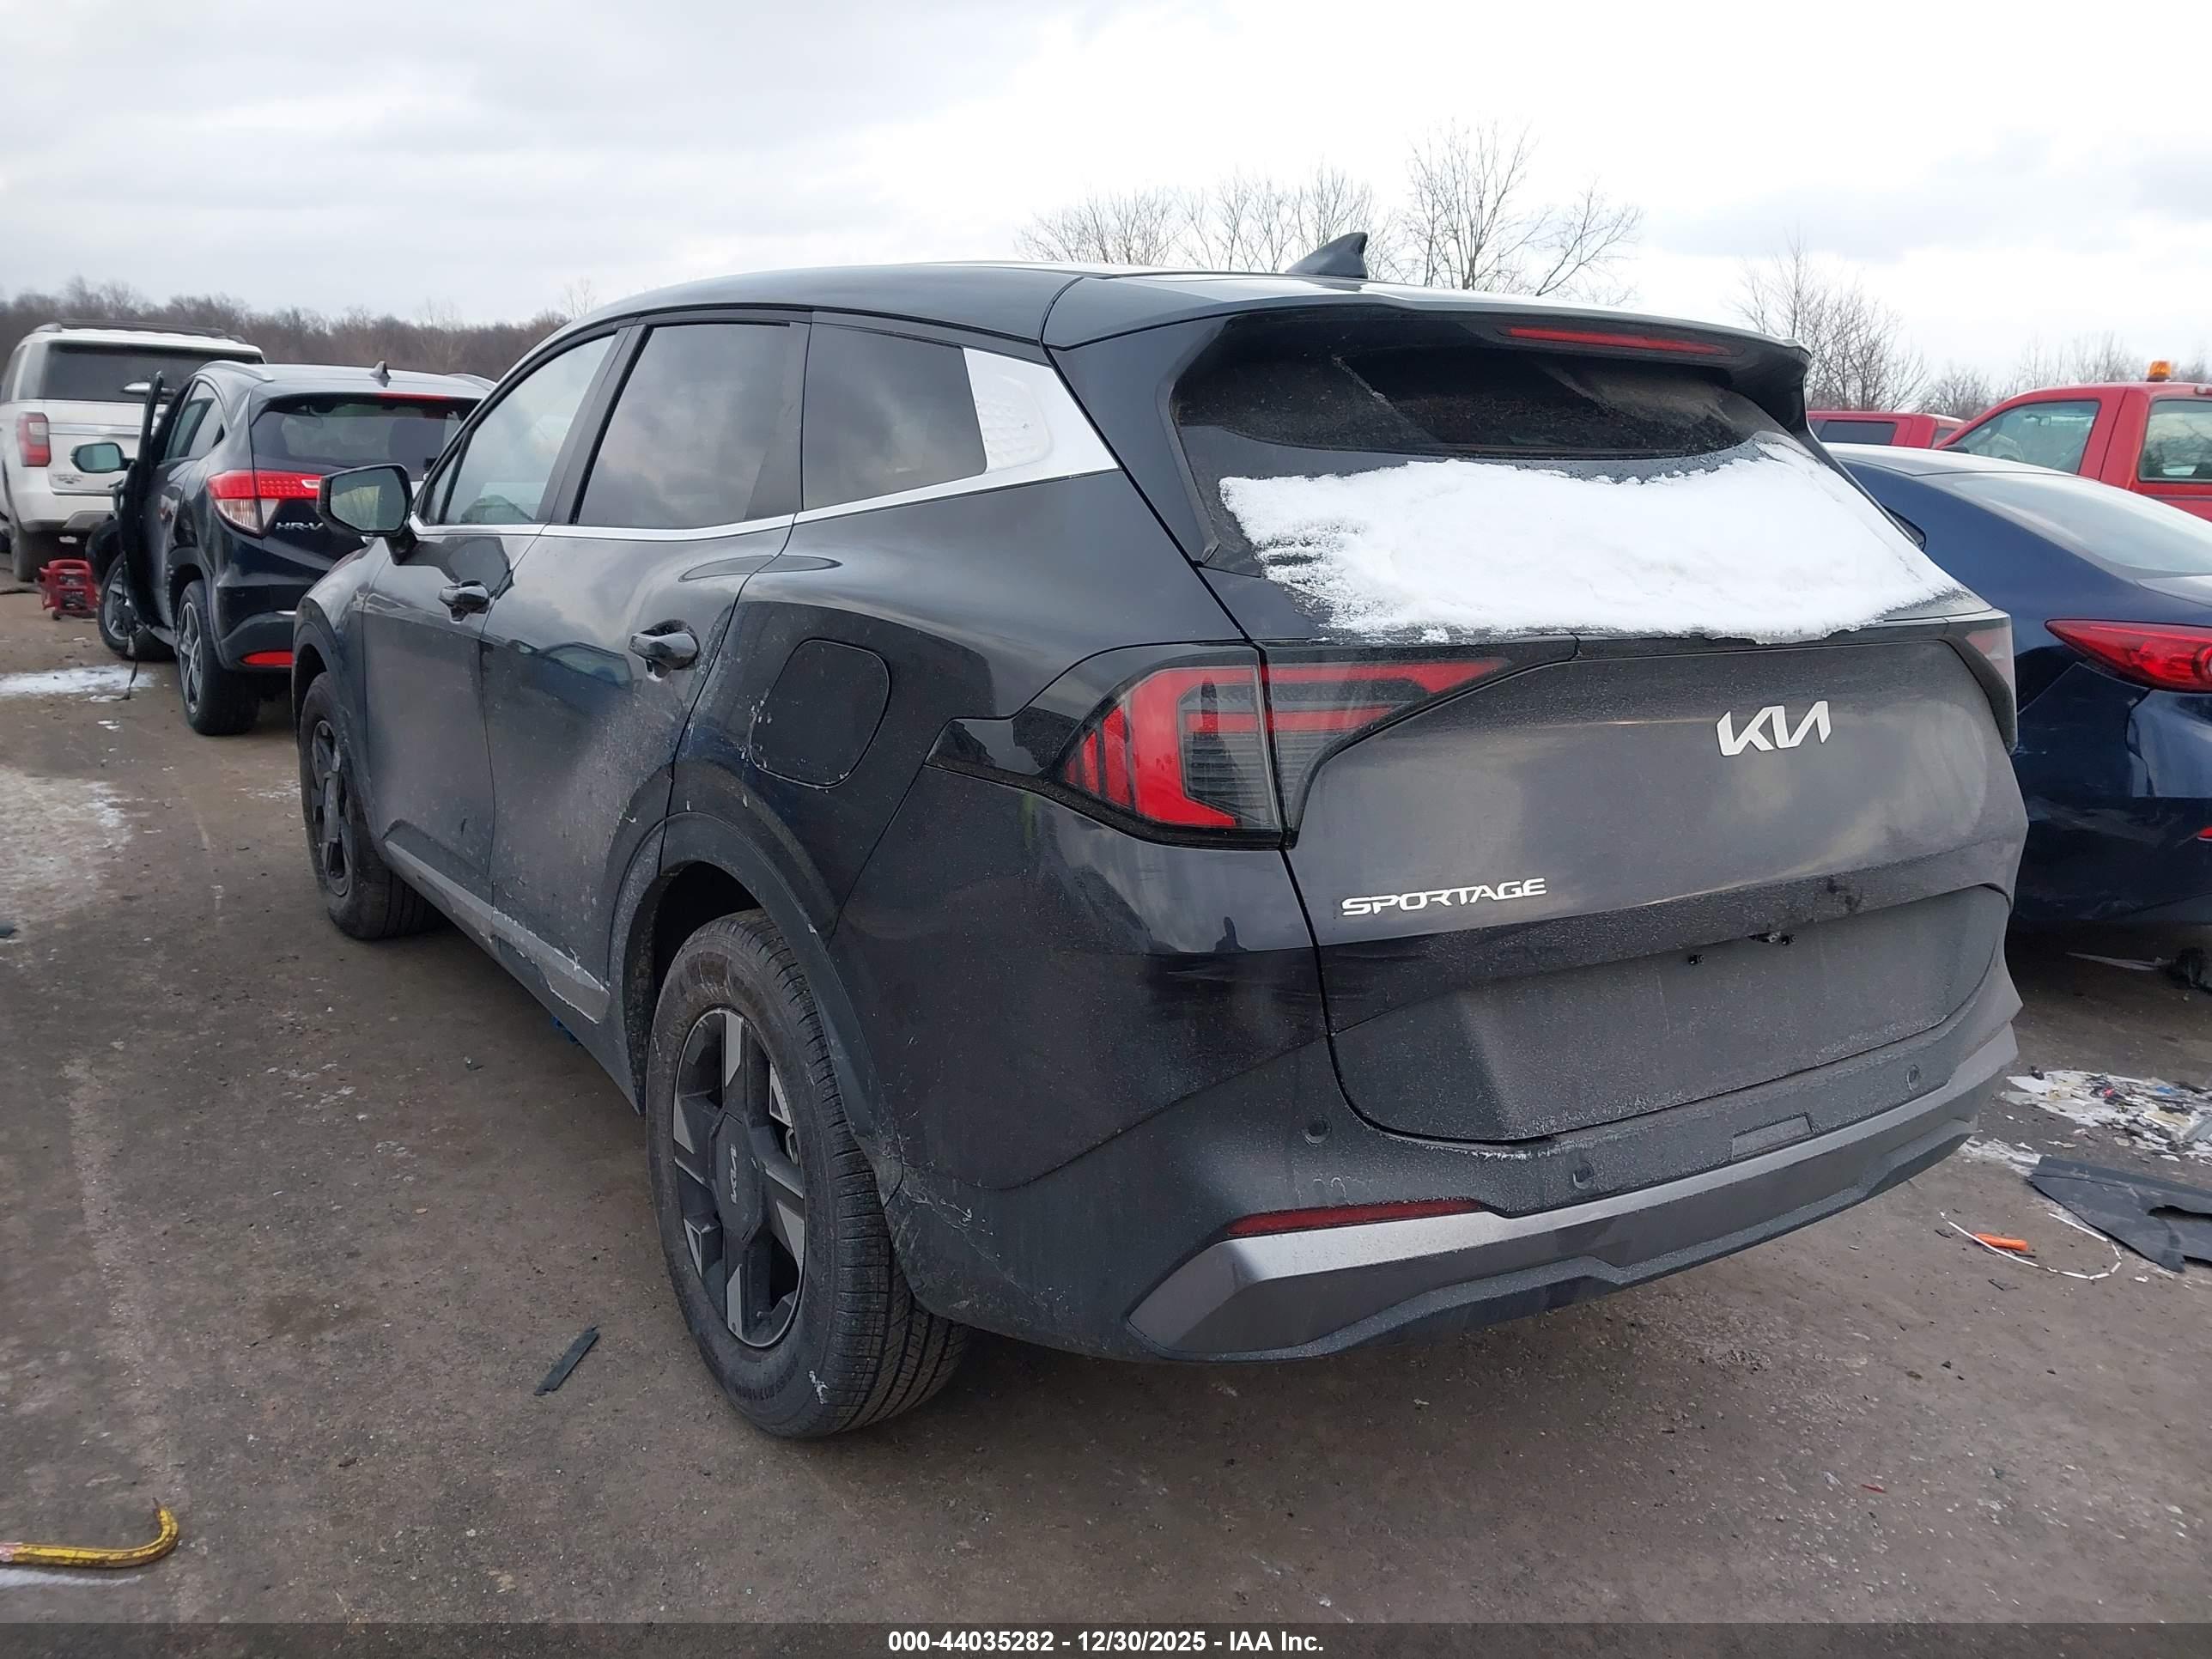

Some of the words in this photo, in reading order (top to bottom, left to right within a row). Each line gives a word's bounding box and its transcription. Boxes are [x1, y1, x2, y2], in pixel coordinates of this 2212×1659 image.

[275, 521, 324, 531] HR-V
[1716, 700, 1832, 757] KIA
[1341, 878, 1547, 916] SPORTAGE
